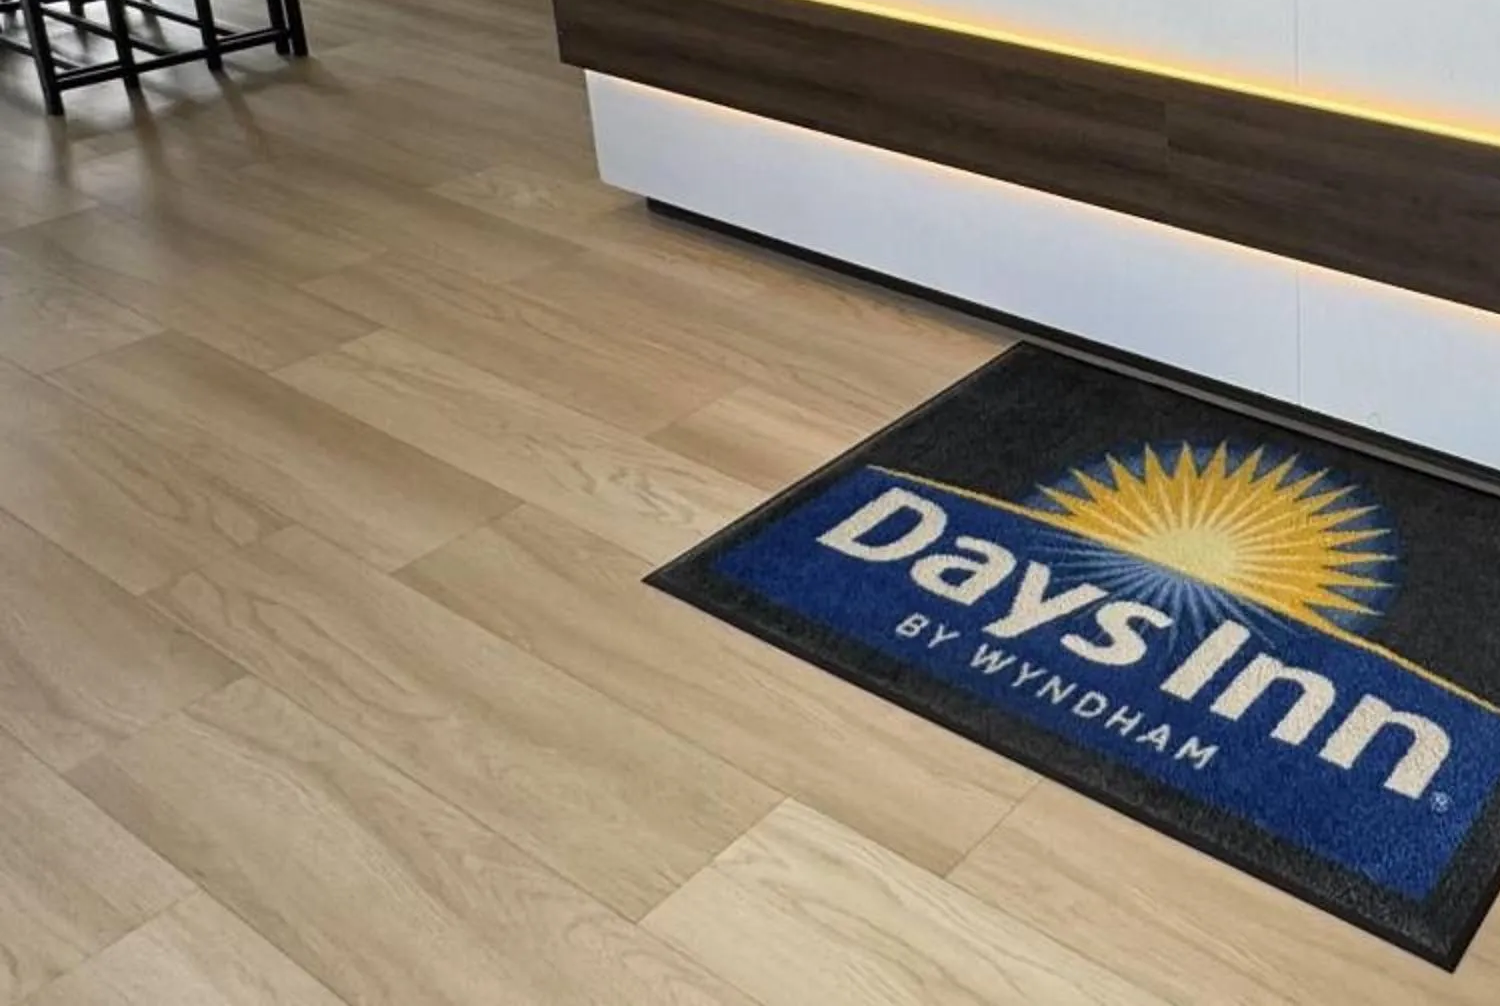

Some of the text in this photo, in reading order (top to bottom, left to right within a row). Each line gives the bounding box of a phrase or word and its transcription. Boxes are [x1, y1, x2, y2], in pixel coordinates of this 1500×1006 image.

[816, 487, 1450, 800] Days Inn
[895, 613, 1219, 770] BY WYNDHAM
